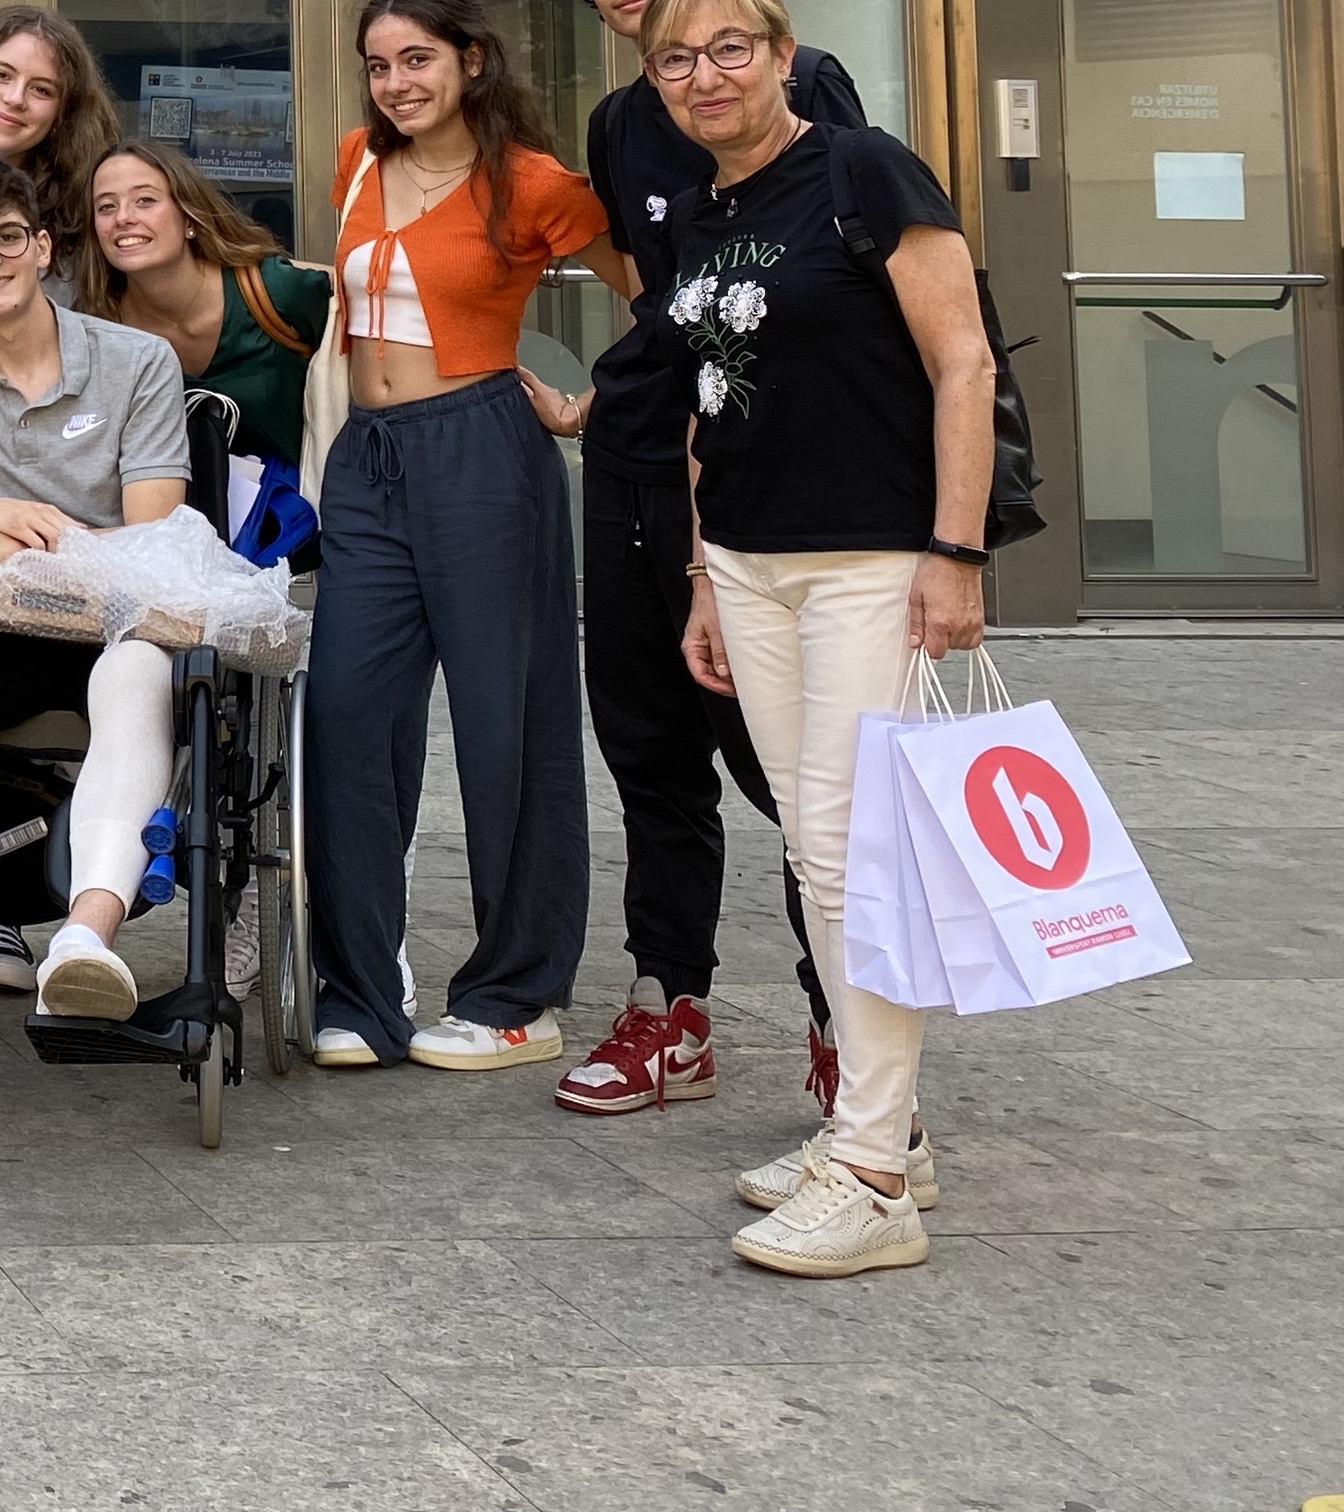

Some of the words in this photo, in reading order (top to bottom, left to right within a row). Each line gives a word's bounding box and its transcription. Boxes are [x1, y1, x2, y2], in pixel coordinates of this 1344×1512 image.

[227, 149, 242, 158] July
[243, 150, 262, 158] 2023
[222, 157, 264, 168] Summer
[68, 413, 98, 429] NIKE
[1032, 903, 1130, 941] Blanquerna
